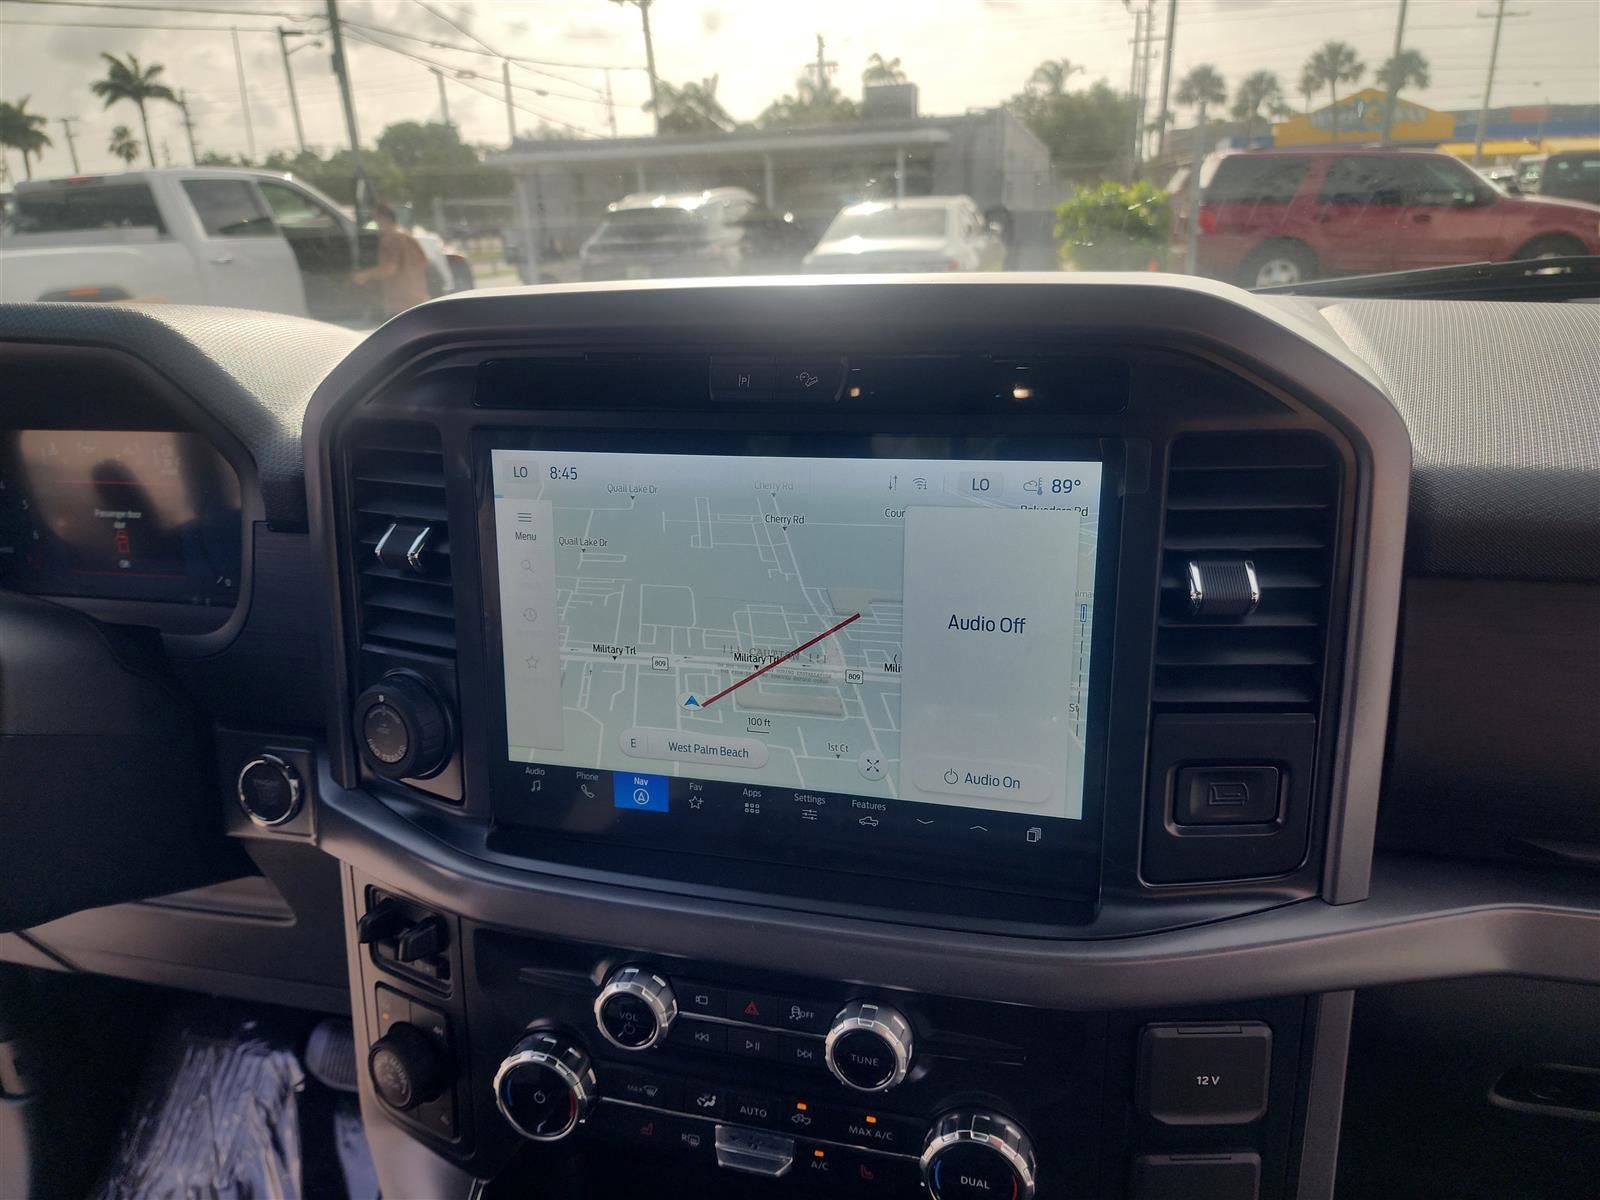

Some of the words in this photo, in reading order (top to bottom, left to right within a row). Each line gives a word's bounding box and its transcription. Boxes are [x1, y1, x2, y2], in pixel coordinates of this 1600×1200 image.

[513, 466, 528, 478] LO
[550, 467, 578, 480] 8:45
[607, 483, 628, 495] Quail
[629, 484, 648, 494] Lake
[649, 485, 658, 494] Dr
[972, 478, 990, 491] LO
[1052, 479, 1081, 493] 89°
[765, 514, 791, 526] Cherry
[793, 516, 805, 525] Rd
[515, 531, 537, 541] Menu
[559, 536, 578, 547] Quail
[580, 537, 598, 547] Lake
[599, 538, 608, 547] Dr
[948, 614, 996, 633] Audio
[1000, 617, 1026, 634] Off
[593, 644, 624, 656] Military
[734, 653, 766, 665] Military
[748, 717, 762, 727] 100
[764, 718, 771, 727] ft
[630, 739, 636, 748] E
[668, 741, 692, 753] West
[694, 744, 718, 756] Palm
[720, 746, 749, 759] Beach
[525, 766, 545, 777] Audio
[576, 771, 599, 781] Phone
[634, 777, 649, 787] Nav
[689, 782, 703, 792] Fav
[964, 772, 1000, 787] Audio
[1002, 776, 1021, 790] On
[743, 787, 762, 799] Apps
[794, 793, 826, 806] Settings
[852, 799, 886, 812] Features
[619, 1011, 639, 1022] VOL
[801, 1011, 815, 1019] OFF
[851, 1053, 880, 1066] TUNE
[1196, 1075, 1209, 1086] 12
[1210, 1076, 1221, 1086] V
[739, 1105, 767, 1118] AUTO
[849, 1125, 871, 1137] MAX
[873, 1129, 894, 1141] A/C
[811, 1159, 829, 1171] A/C
[961, 1175, 991, 1190] DUAL
